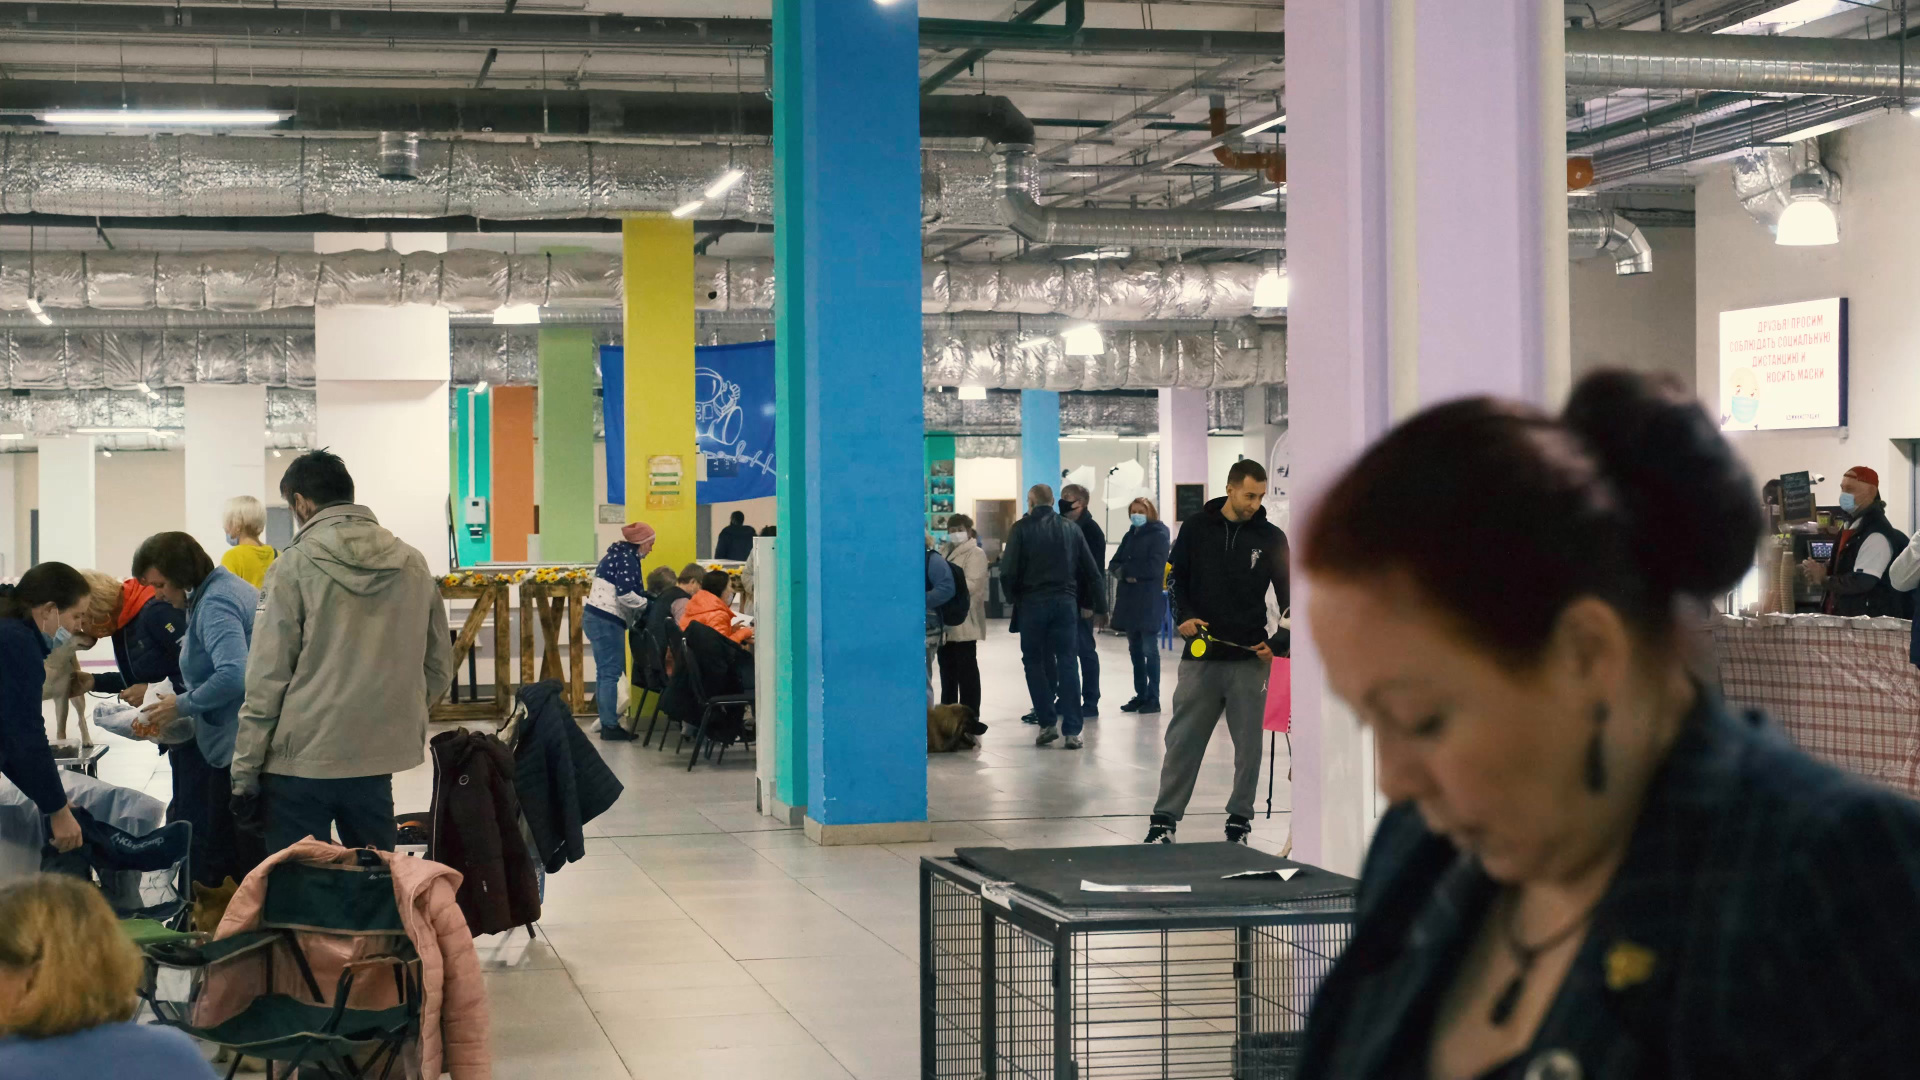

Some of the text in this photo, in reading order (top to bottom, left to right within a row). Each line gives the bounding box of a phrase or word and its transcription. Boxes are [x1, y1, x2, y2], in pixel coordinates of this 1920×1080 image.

[1757, 314, 1823, 333] ДРУЗЬЯ! ПРОСИМ
[1729, 331, 1831, 352] СОБЛЮДАТЬ СОЦИАЛЬНУЮ
[1752, 352, 1806, 368] ДИСТАНЦИЮ И
[1766, 367, 1825, 383] НОСИТЬ МАСКИ
